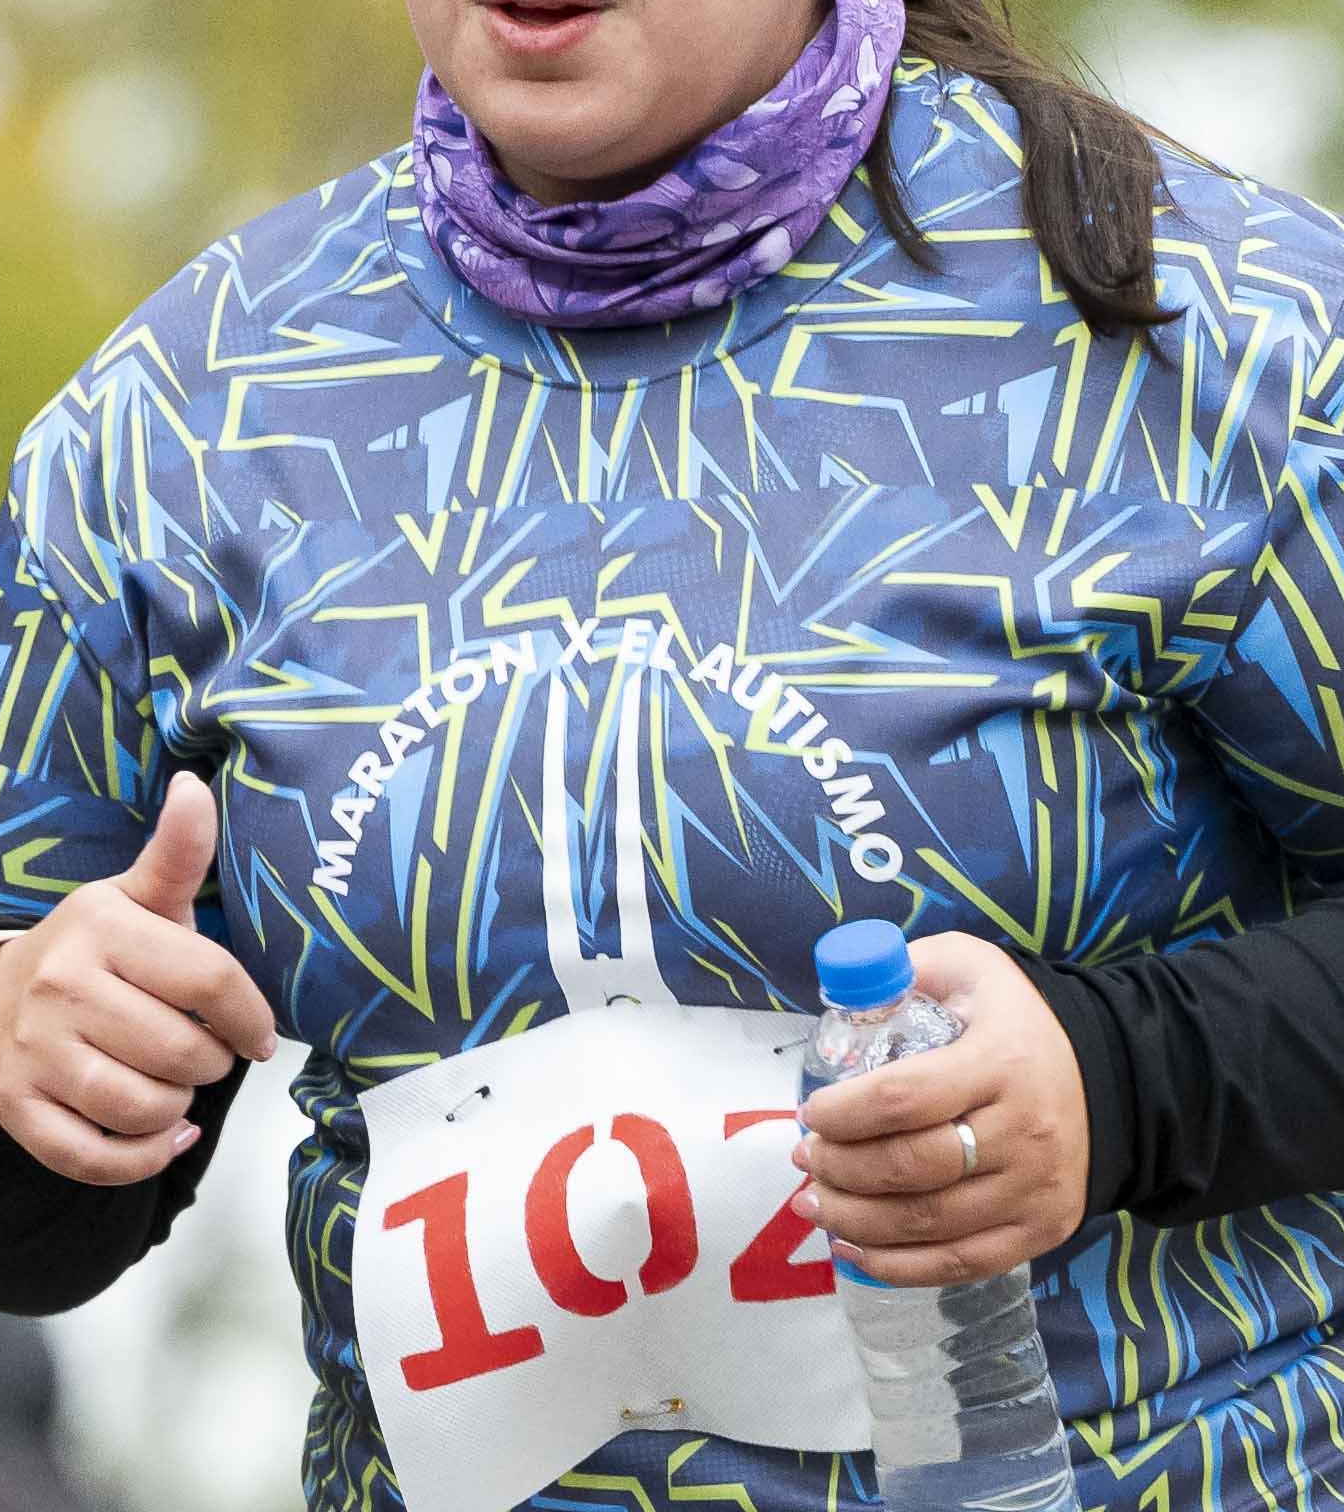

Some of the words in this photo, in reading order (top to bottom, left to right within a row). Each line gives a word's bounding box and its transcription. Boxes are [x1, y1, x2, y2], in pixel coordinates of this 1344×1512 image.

[312, 630, 538, 896] MARATÓN
[558, 617, 599, 664] X
[618, 618, 677, 671] EL
[689, 642, 904, 884] AUTISMO
[381, 1108, 838, 1391] 102
